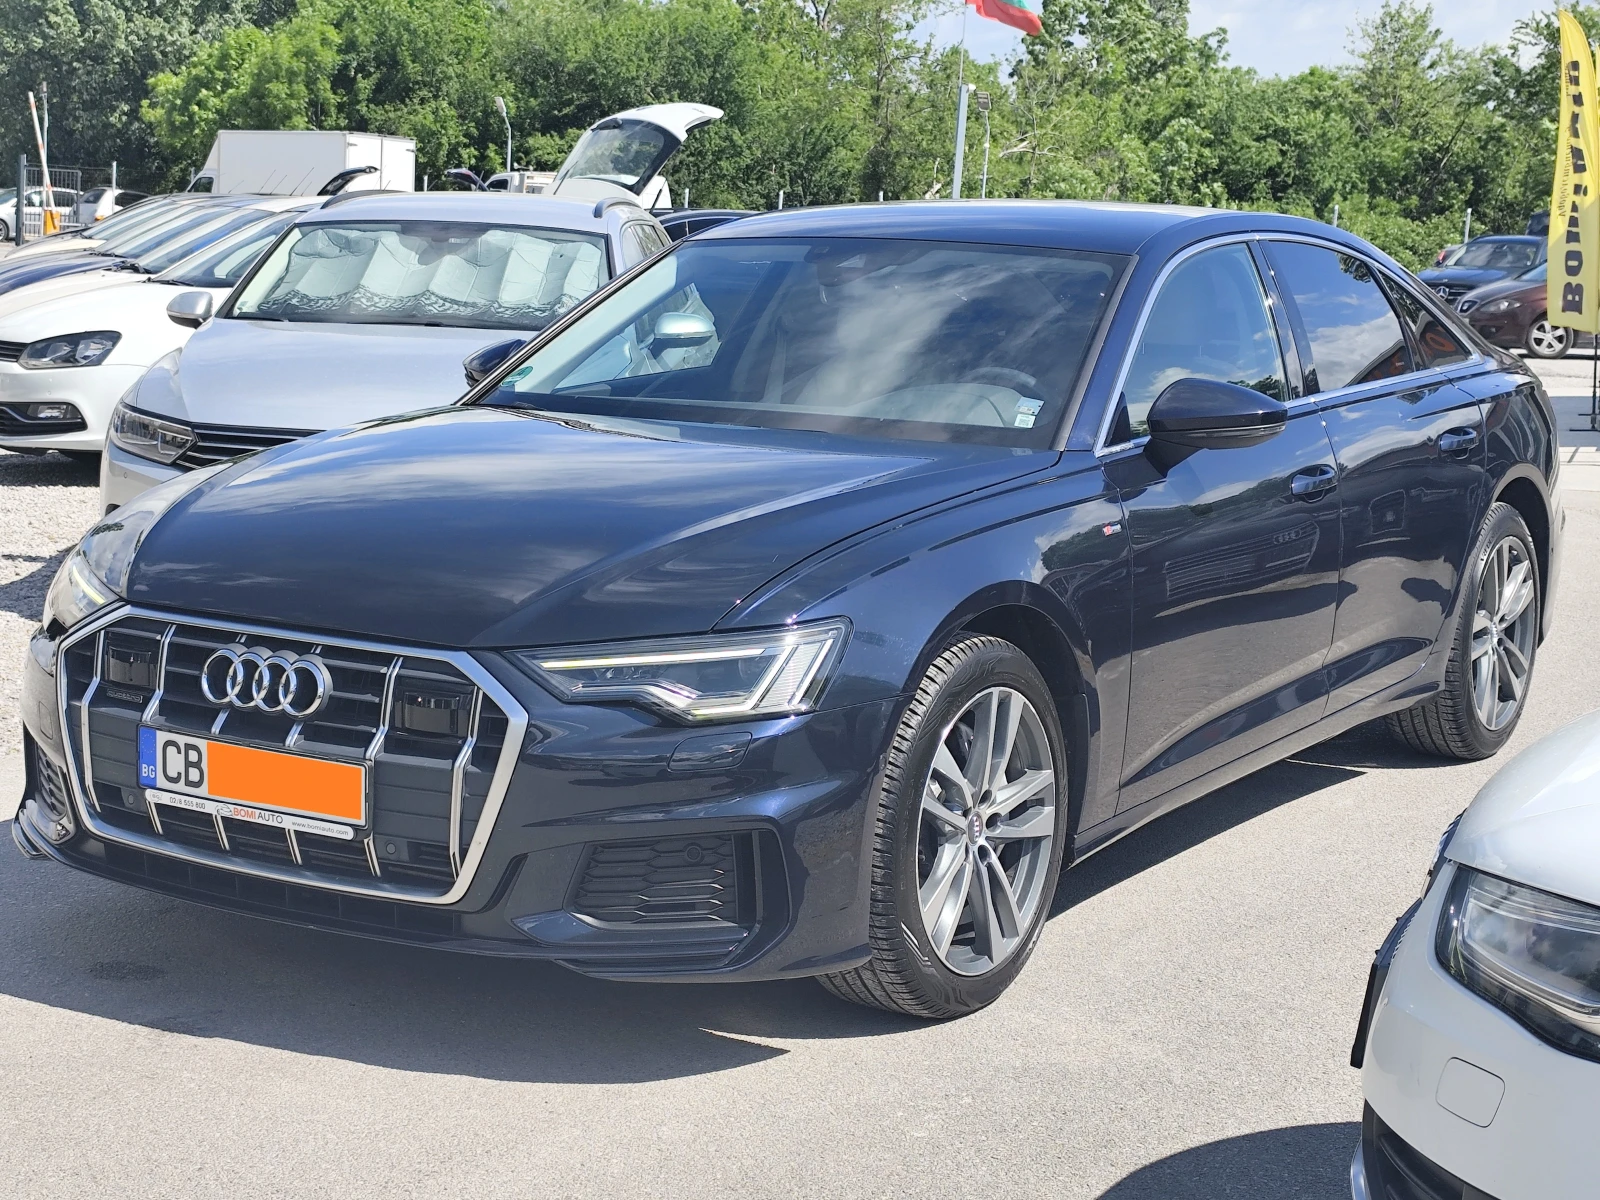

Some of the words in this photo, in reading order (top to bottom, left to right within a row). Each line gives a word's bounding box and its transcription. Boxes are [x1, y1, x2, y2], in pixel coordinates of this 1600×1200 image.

[142, 763, 156, 778] BG
[162, 739, 205, 788] CB
[195, 801, 205, 809] 800
[233, 807, 256, 819] BOMI
[257, 811, 284, 824] AUTO
[291, 820, 349, 836] www.bomiauto.com
